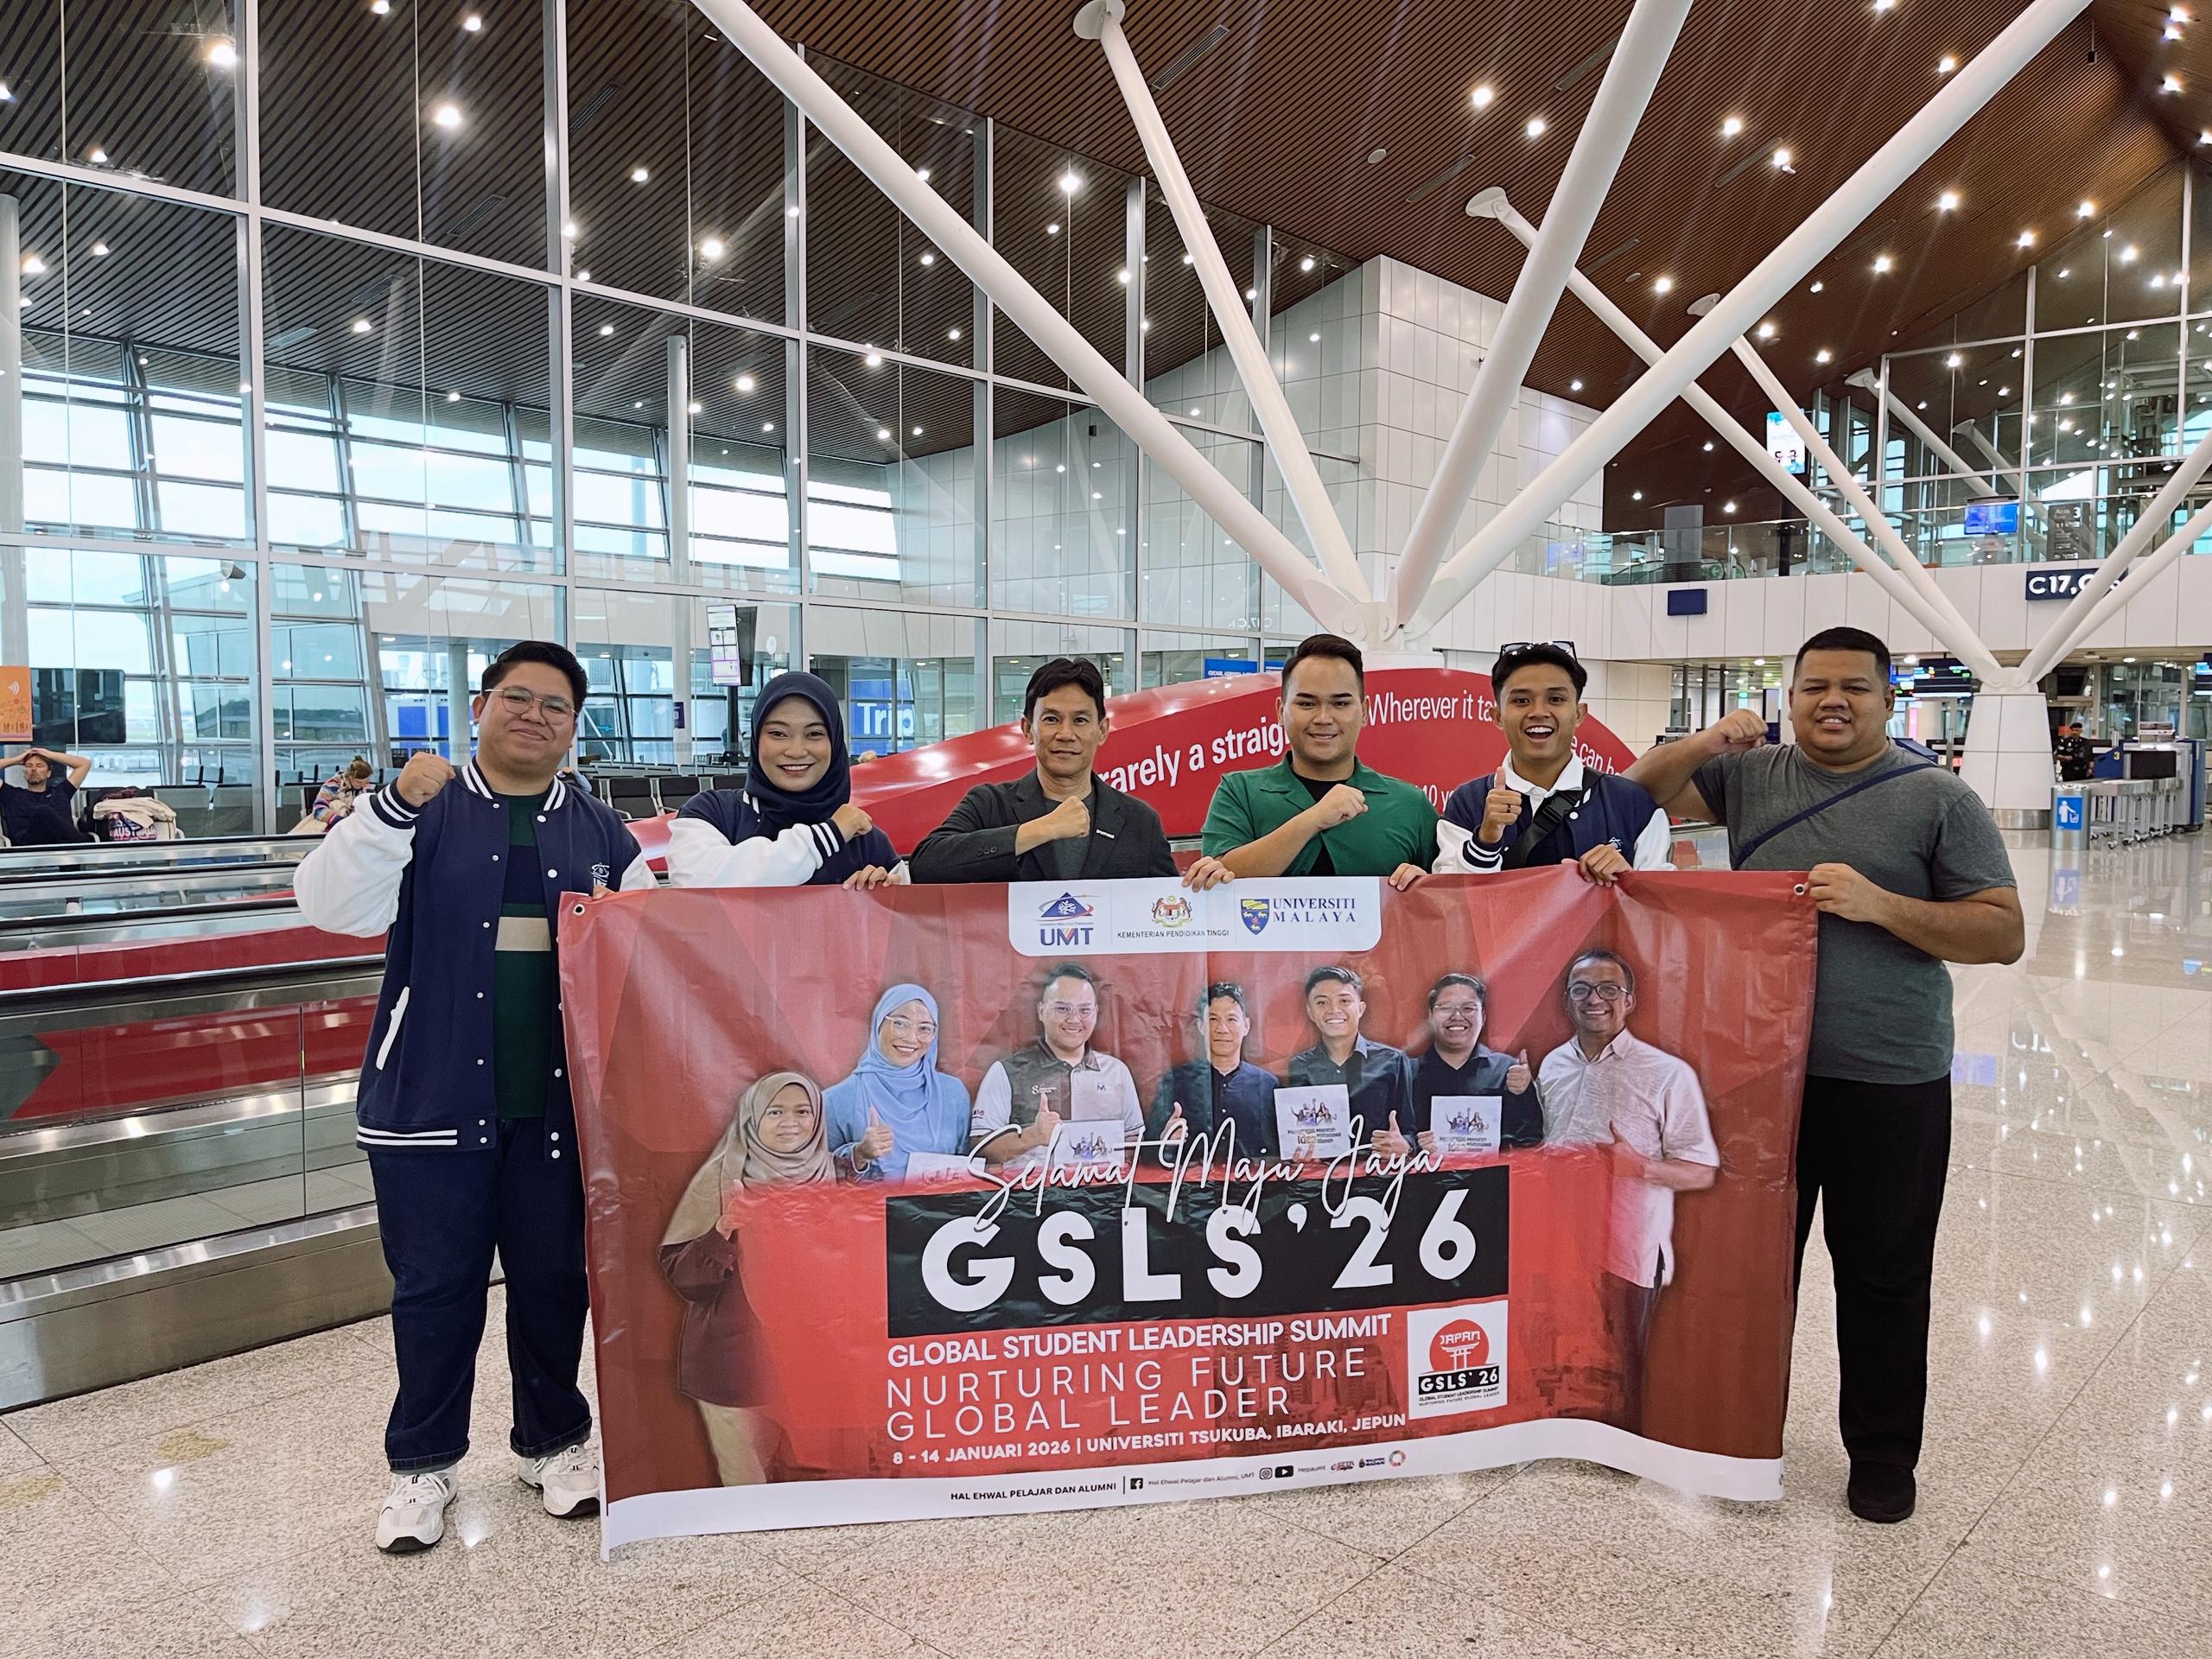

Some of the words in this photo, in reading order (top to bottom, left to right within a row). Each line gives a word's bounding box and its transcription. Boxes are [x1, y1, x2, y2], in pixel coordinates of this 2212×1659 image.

[2074, 505, 2082, 518] 3
[1366, 691, 1456, 727] Wherever
[1462, 690, 1474, 720] it
[1478, 700, 1497, 722] ta
[1580, 743, 1604, 772] can
[1097, 744, 1181, 793] rarely
[1188, 743, 1205, 771] a
[2113, 751, 2120, 760] 3
[1273, 898, 1356, 909] UNIVERSITI
[1273, 912, 1356, 923] MALAYA
[1040, 927, 1094, 946] UMT
[967, 1122, 1186, 1231] Selamat
[1159, 1116, 1300, 1236] Maju
[1320, 1114, 1444, 1231] Jaya
[887, 1338, 996, 1368] GLOBAL
[1003, 1329, 1122, 1359] STUDENT
[1128, 1321, 1283, 1351] LEADERSHIP
[1290, 1313, 1392, 1342] SUMMIT
[887, 1360, 1161, 1408] NURTURING
[1192, 1347, 1365, 1387] FUTURE
[1478, 1368, 1498, 1385] 26
[887, 1398, 1080, 1441] GLOBAL
[1110, 1386, 1290, 1426] LEADER
[893, 1452, 903, 1465] 8
[920, 1450, 940, 1463] 14
[945, 1444, 1022, 1462] JANUARI
[1028, 1440, 1071, 1457] 2026
[1087, 1432, 1184, 1452] UNIVERSITI
[1190, 1426, 1272, 1444] TSUKUBA,
[1277, 1421, 1347, 1438] IBARAKI,
[1351, 1414, 1406, 1431] JEPUN
[973, 1491, 1007, 1500] EHWAL
[1009, 1487, 1052, 1497] PELAJAR
[1055, 1485, 1076, 1495] DAN
[1077, 1483, 1116, 1492] ALUMNI
